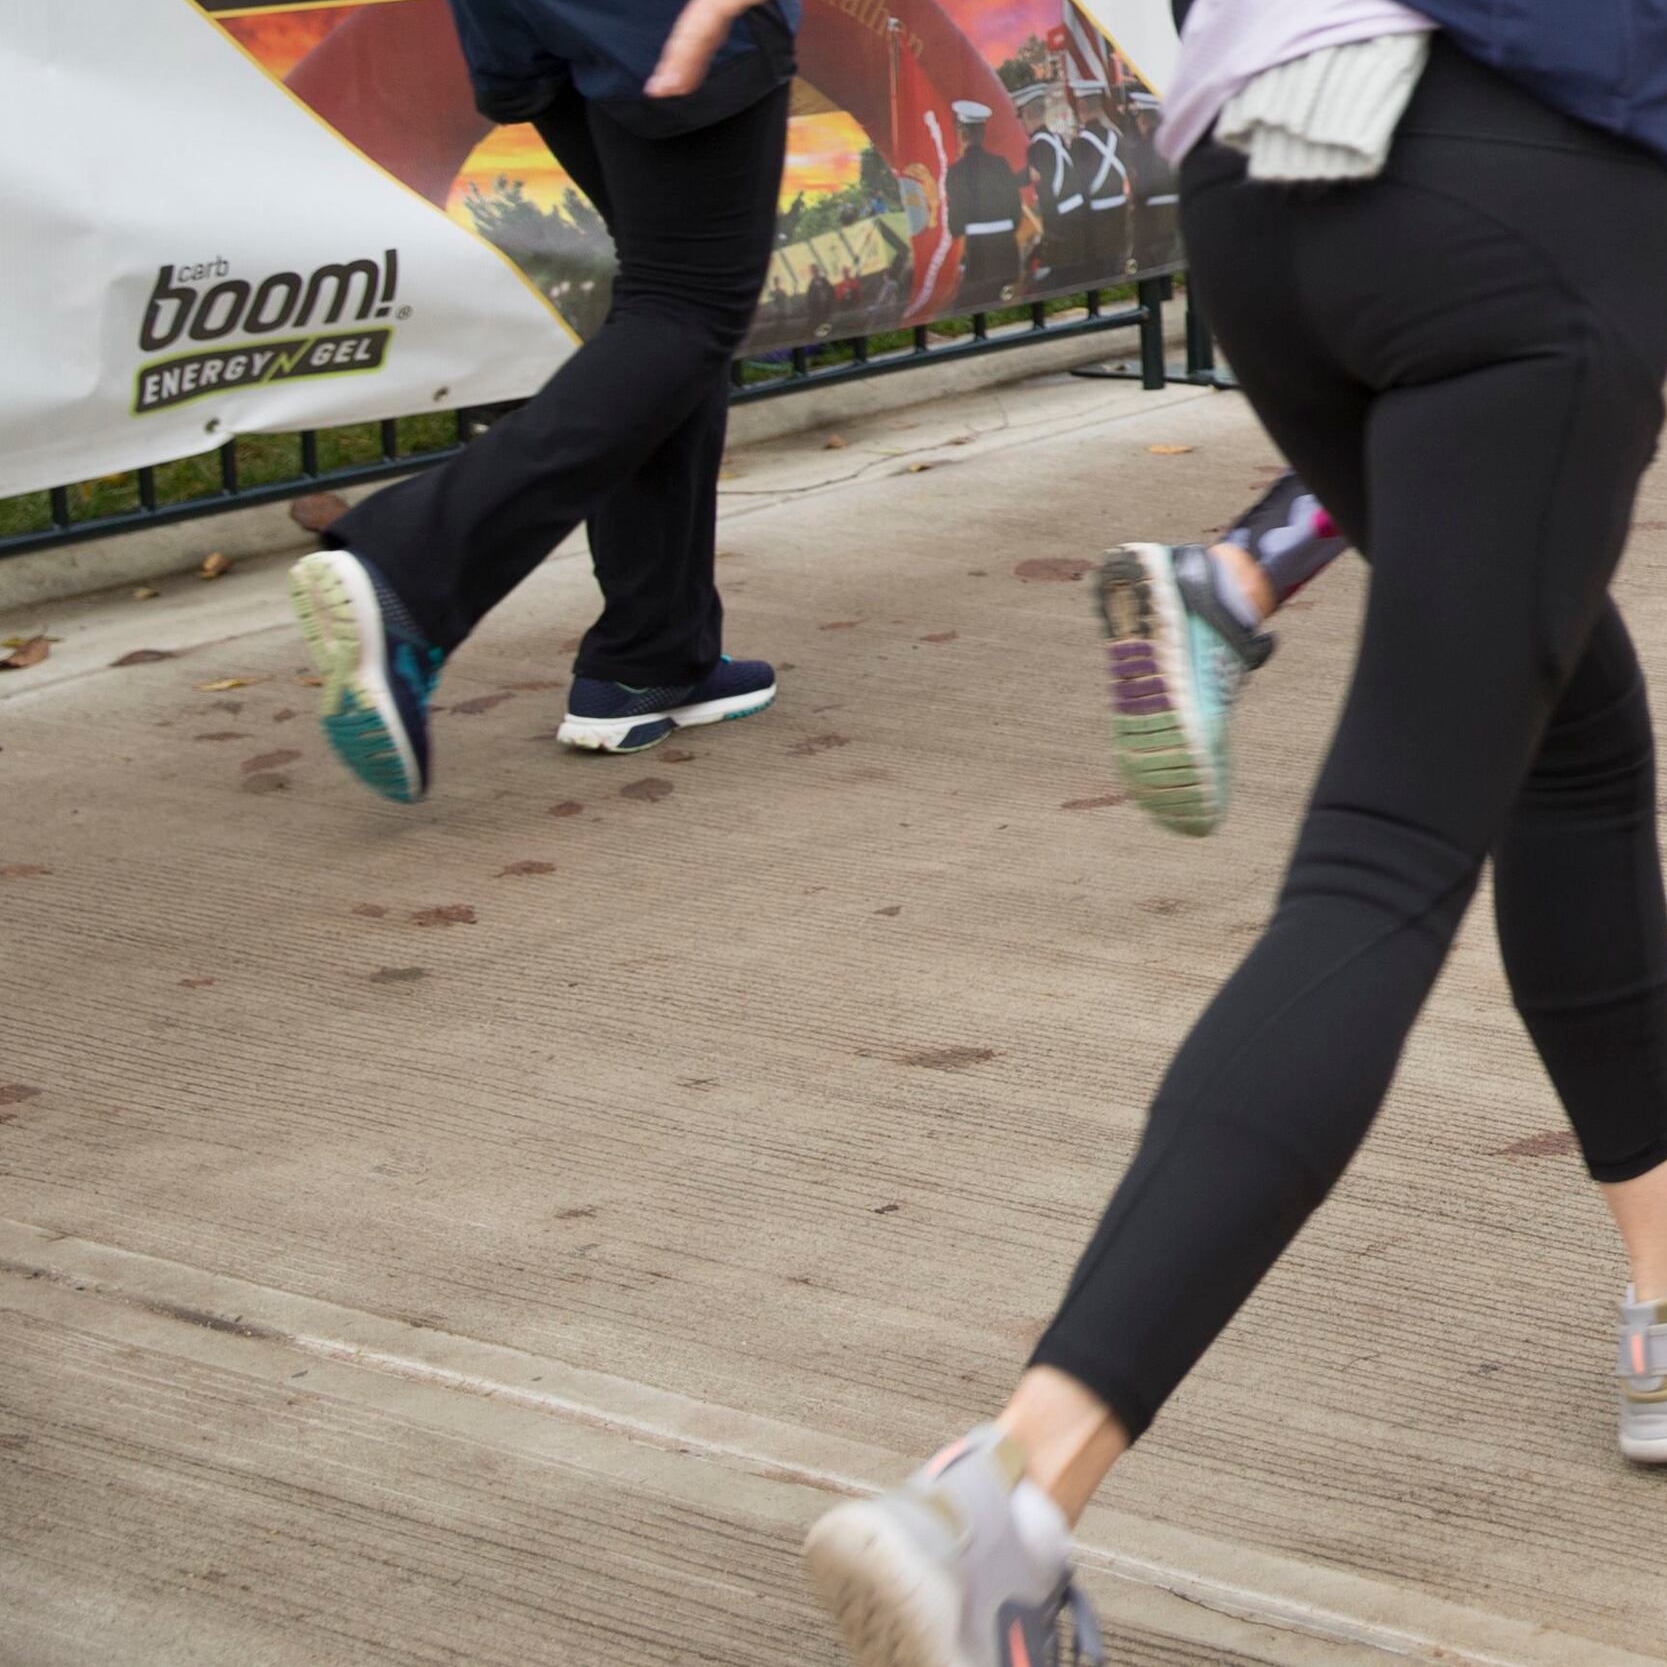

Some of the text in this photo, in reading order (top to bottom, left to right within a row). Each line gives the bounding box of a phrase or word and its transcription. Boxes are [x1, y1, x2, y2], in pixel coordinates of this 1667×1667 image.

[140, 248, 398, 352] boom!
[176, 255, 230, 284] carb
[142, 337, 372, 406] ENERGY GEL
